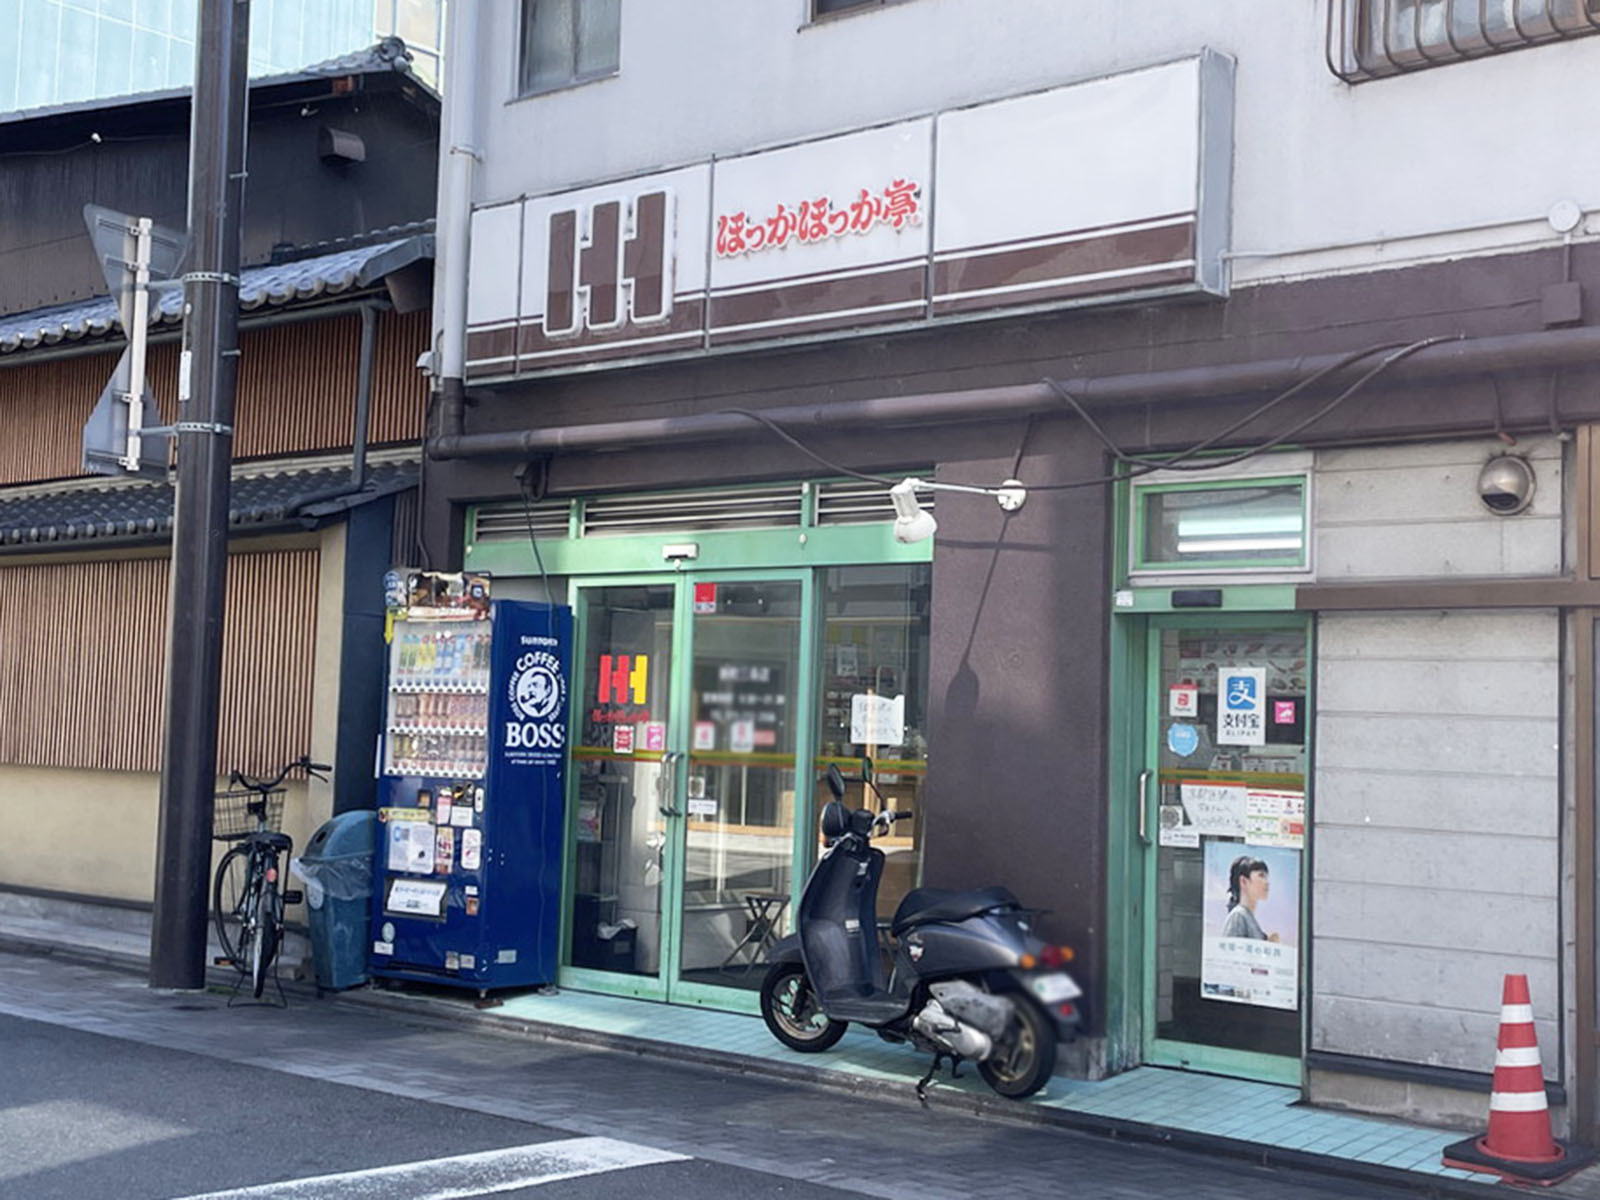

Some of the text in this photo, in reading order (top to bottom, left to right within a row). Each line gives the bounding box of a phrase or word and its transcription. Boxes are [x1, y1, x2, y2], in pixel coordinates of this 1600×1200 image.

[716, 178, 917, 255] ほっかほっか亭
[516, 651, 560, 674] COFFEE
[1222, 712, 1260, 729] 支付宝
[505, 722, 566, 749] BOSS
